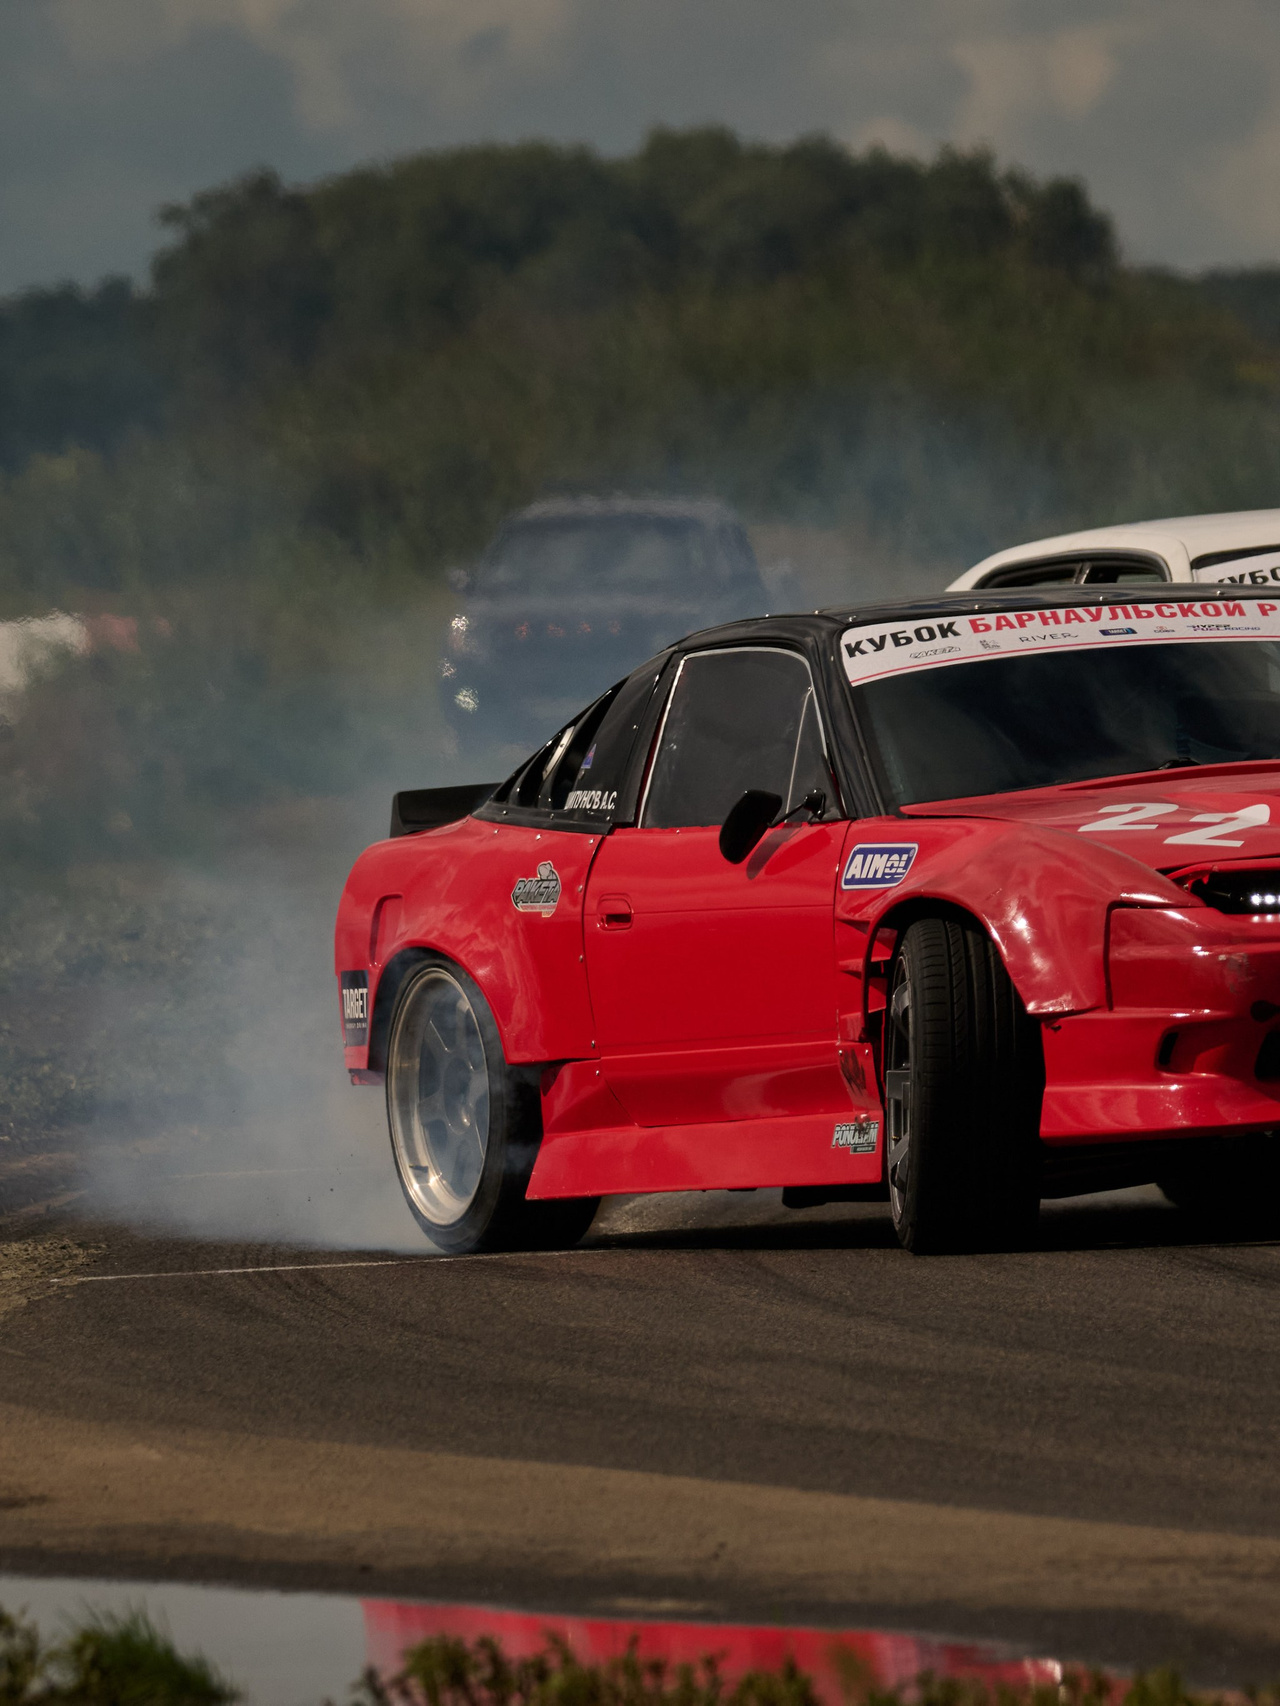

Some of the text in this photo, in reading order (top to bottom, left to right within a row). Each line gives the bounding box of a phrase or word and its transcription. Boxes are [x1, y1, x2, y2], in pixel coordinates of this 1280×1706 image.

[845, 621, 962, 658] КУБОК
[968, 599, 1246, 634] БАРНАУЛЬСКОЙ
[1020, 632, 1079, 643] RIVER
[1077, 802, 1271, 848] 22
[845, 853, 909, 879] AIMOL
[342, 987, 368, 1019] TARGET
